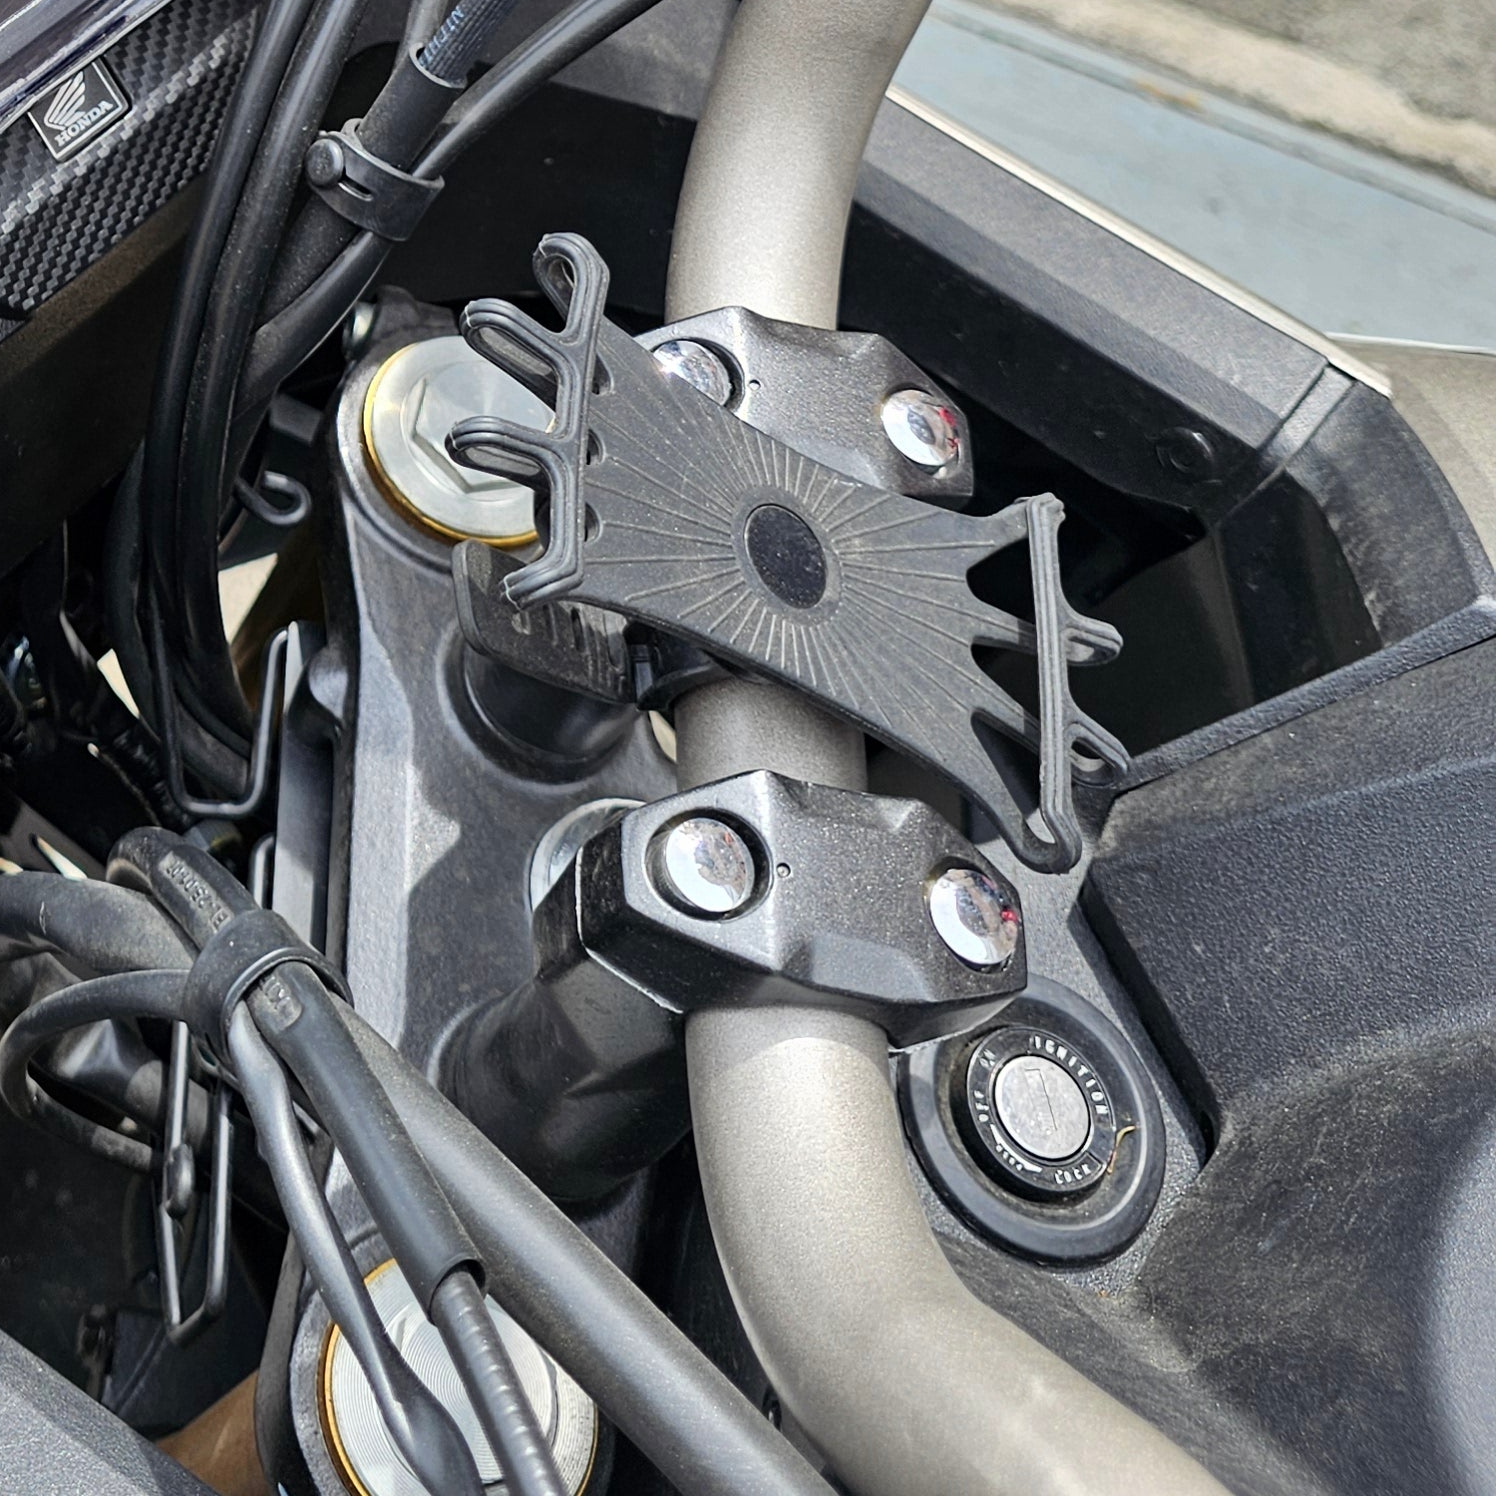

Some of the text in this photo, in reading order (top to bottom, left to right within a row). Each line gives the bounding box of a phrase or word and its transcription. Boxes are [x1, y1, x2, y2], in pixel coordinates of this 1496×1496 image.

[54, 100, 113, 147] HONDA
[1034, 1035, 1109, 1114] IGNITION
[974, 1090, 990, 1122] OFF
[1054, 1163, 1092, 1184] LOCK
